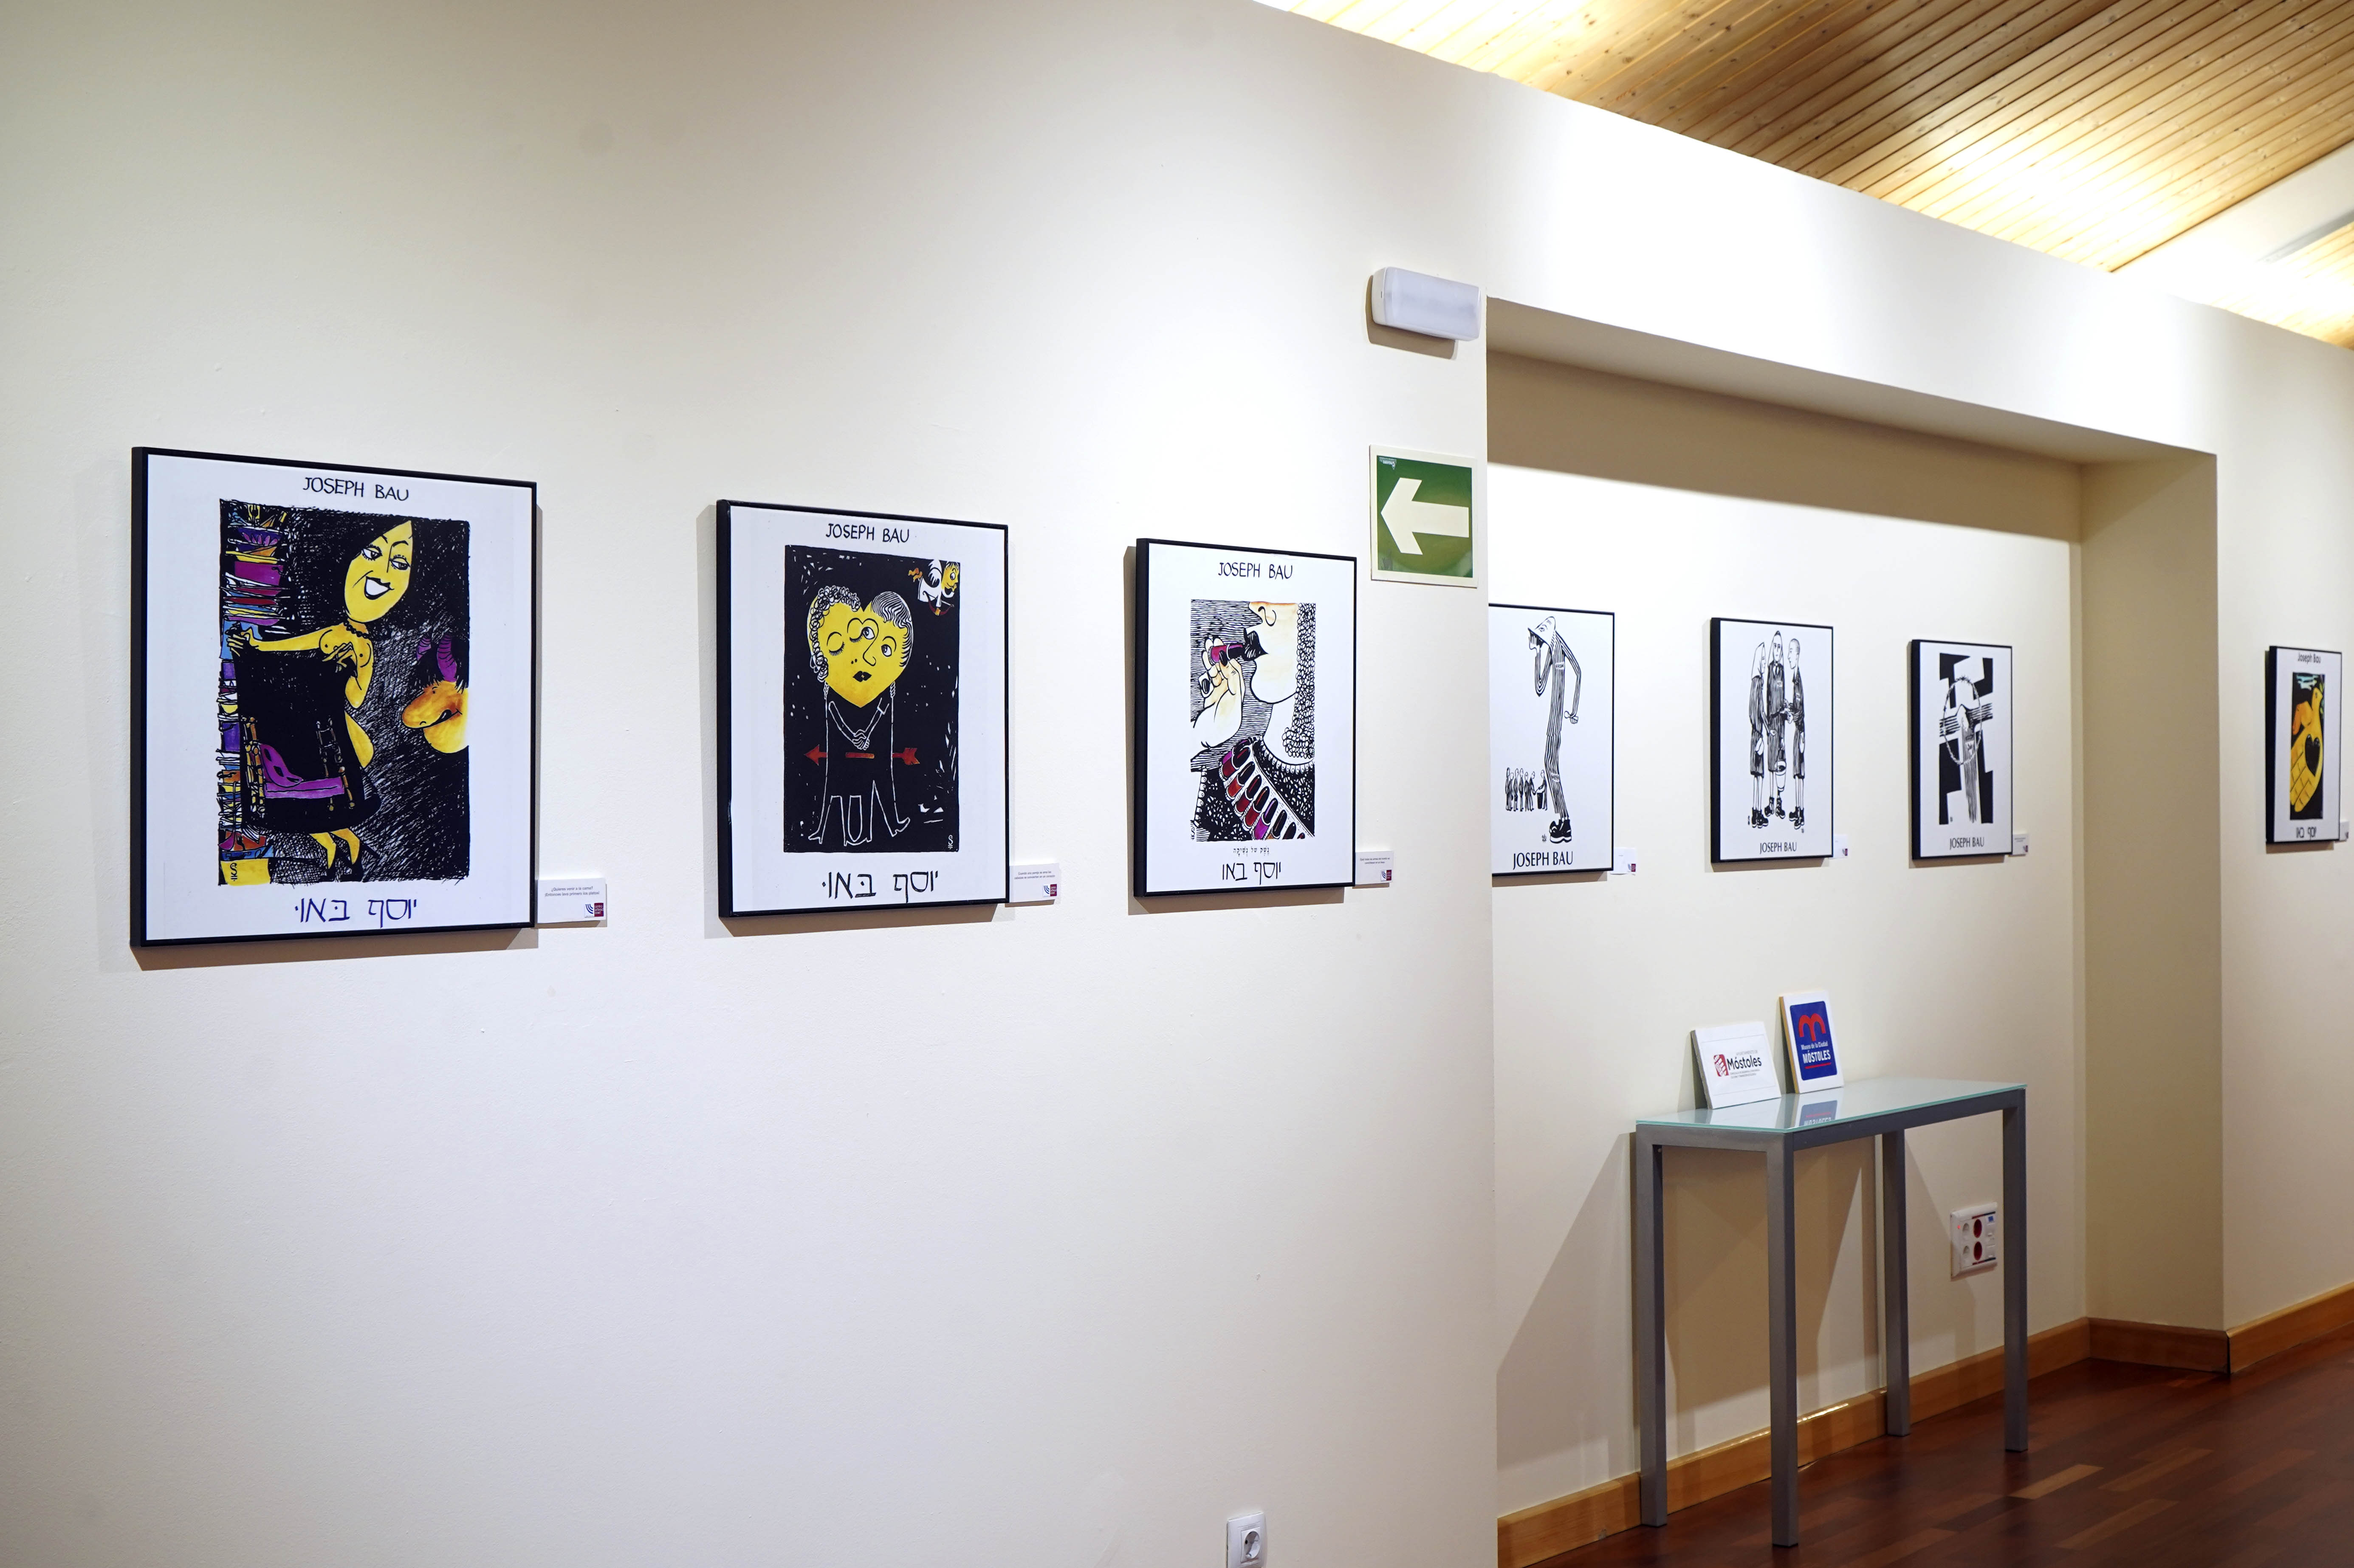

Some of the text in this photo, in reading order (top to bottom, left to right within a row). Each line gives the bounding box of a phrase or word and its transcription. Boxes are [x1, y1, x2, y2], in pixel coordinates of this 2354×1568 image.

[302, 477, 409, 501] JOSEPH BAU
[825, 523, 909, 543] JOSEPH BAU
[1218, 562, 1293, 580] JOSEPH BAU
[2298, 653, 2321, 664] Joseph Bau
[1760, 842, 1797, 855] JOSEPH BAU
[1950, 837, 1984, 850] JOSEPH BAU
[1513, 851, 1573, 870] JOSEPH BAU
[1222, 862, 1281, 885] יוסף באו
[893, 871, 939, 903] יוסף
[368, 899, 417, 928] יוסף
[1727, 1054, 1762, 1069] Móstoles
[1802, 1049, 1831, 1064] MÓSTOLES
